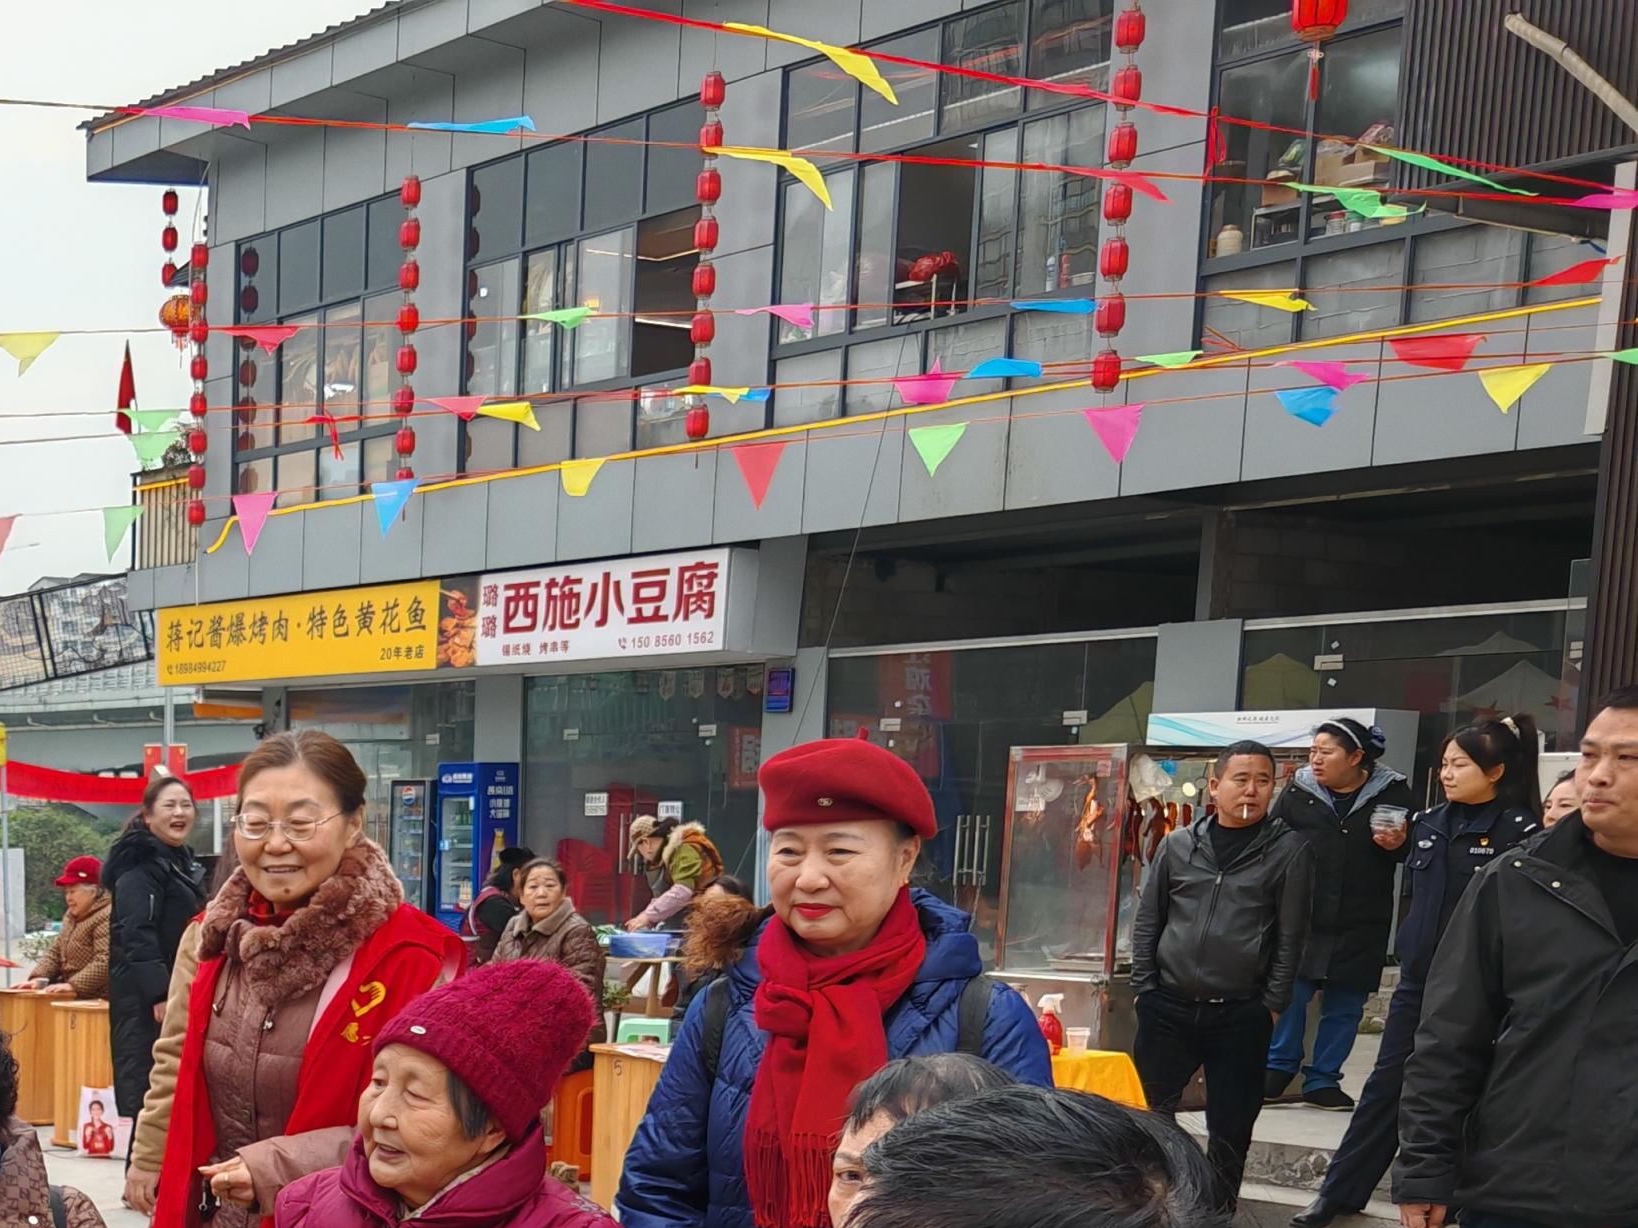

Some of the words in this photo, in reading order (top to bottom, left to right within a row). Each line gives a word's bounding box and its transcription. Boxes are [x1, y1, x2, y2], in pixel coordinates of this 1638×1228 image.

[502, 561, 720, 635] 西施小豆腐
[481, 583, 499, 639] 璐璐
[631, 636, 651, 650] 150
[654, 633, 682, 648] 8560
[687, 631, 715, 645] 1562
[379, 644, 425, 662] 20年老店
[613, 1060, 624, 1077] 5
